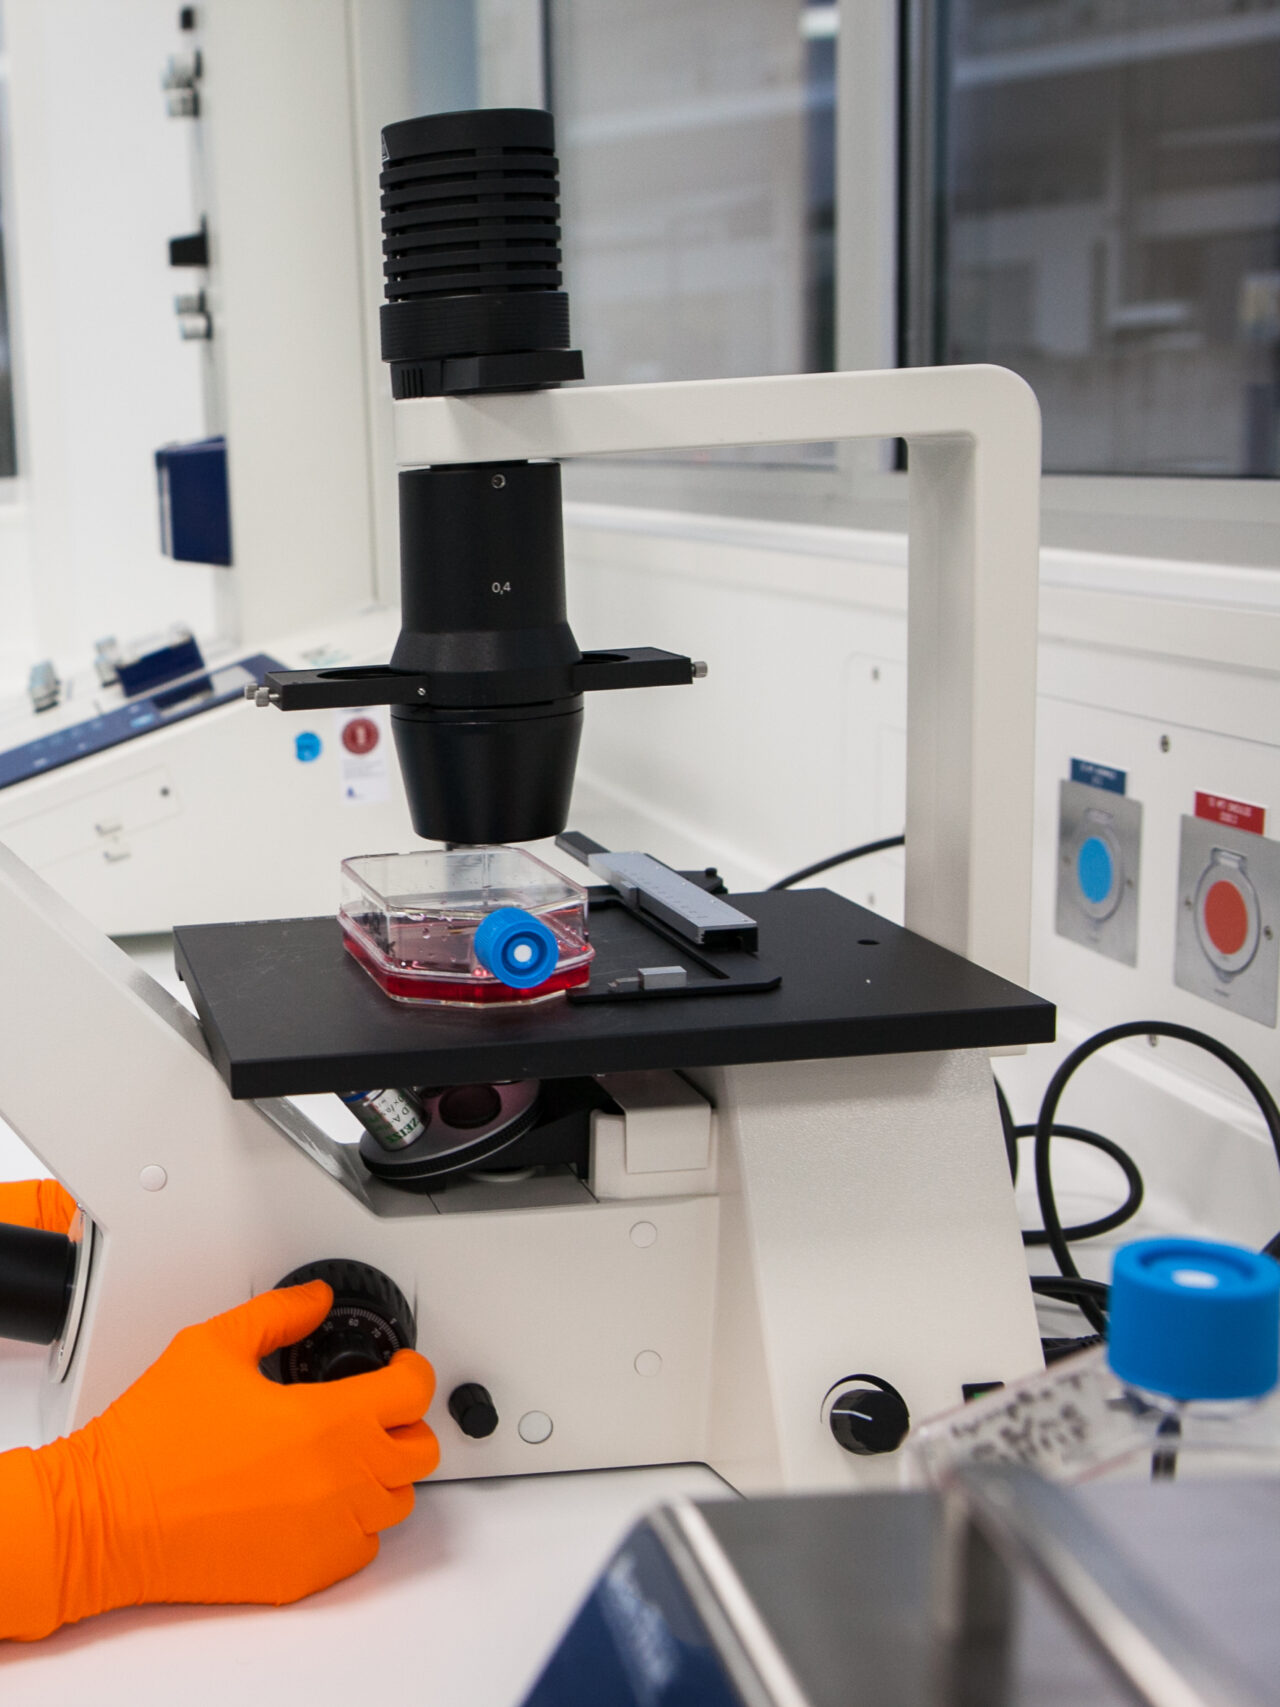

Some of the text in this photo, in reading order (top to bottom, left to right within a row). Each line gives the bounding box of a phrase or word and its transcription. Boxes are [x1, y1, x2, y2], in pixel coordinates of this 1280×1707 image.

[491, 581, 511, 595] 0,4
[348, 1318, 359, 1328] 60
[371, 1328, 381, 1339] 70
